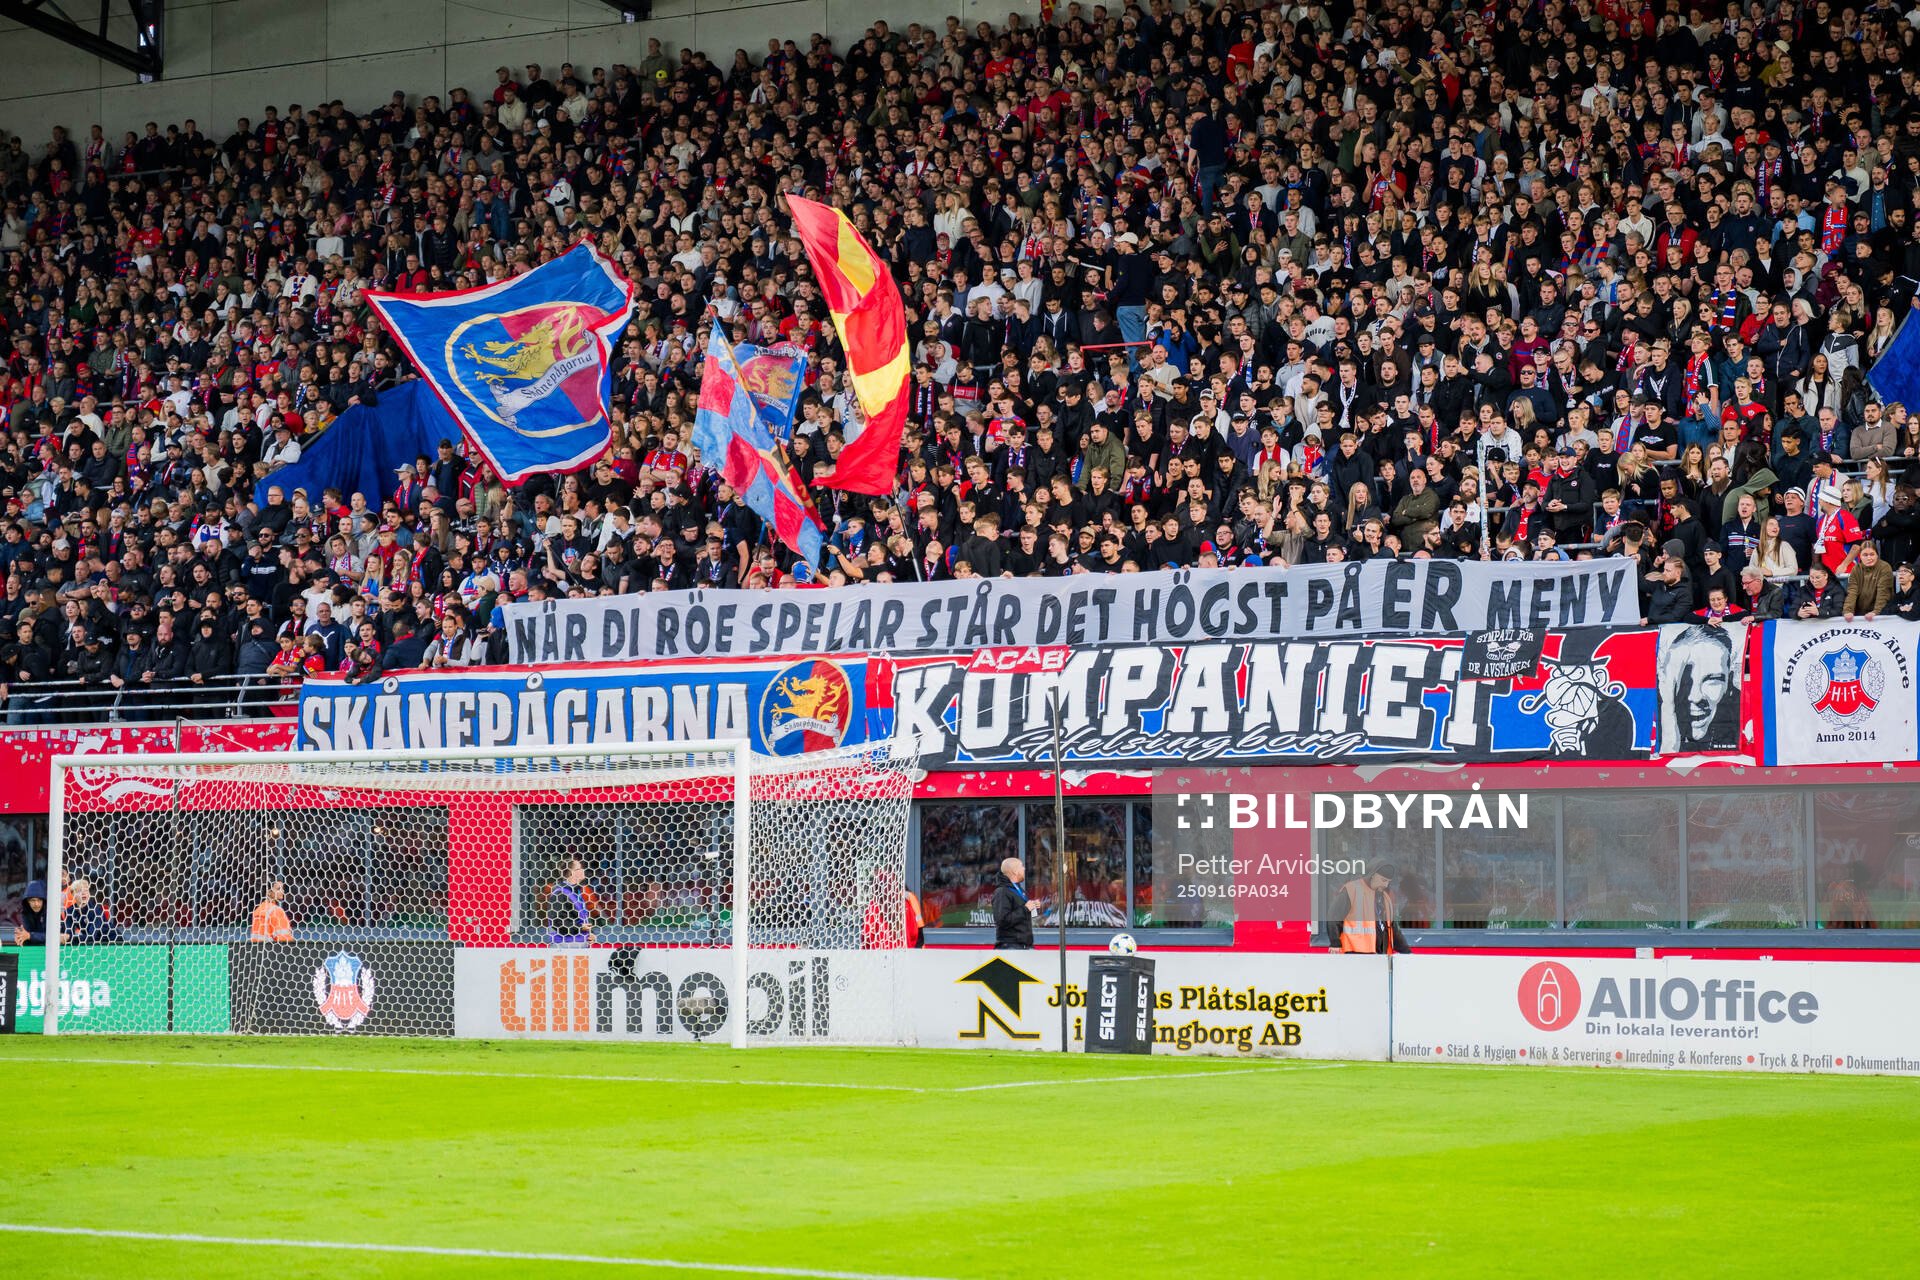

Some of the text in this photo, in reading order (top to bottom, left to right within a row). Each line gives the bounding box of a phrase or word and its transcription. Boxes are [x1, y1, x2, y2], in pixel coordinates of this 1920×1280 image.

[515, 560, 1627, 664] NÄR DI RÖE SPELAR STÅR DET HÖGST PÅ ER MENY
[1477, 629, 1515, 643] SYMPATI
[971, 646, 1066, 673] ACAB
[1468, 662, 1481, 674] DE
[1782, 628, 1910, 694] Helsingborgs Äldre
[302, 671, 748, 757] SKÅNEPÅGARNA
[1008, 724, 1366, 761] Helsingborg
[1816, 731, 1876, 743] Anno 2014
[1099, 975, 1118, 1041] SELECT
[1136, 975, 1149, 1041] SELECT
[1180, 987, 1328, 1019] Plåtslageri
[1587, 977, 1819, 1024] AllOffice
[1259, 1023, 1301, 1046] AB
[1586, 1022, 1759, 1038] Din lokala leverantör!
[1399, 1042, 1432, 1057] Kontor
[1447, 1043, 1470, 1058] Städ
[1474, 1045, 1480, 1058] &
[1484, 1045, 1516, 1063] Hygien
[1529, 1046, 1548, 1060] Kök
[1552, 1047, 1559, 1060] &
[1563, 1047, 1612, 1064] Servering
[1626, 1049, 1675, 1066] Inredning
[1678, 1050, 1686, 1064] &
[1690, 1050, 1742, 1066] Konferens
[1759, 1052, 1786, 1069] Tryck
[1791, 1054, 1799, 1067] &
[1803, 1054, 1832, 1068] Profil
